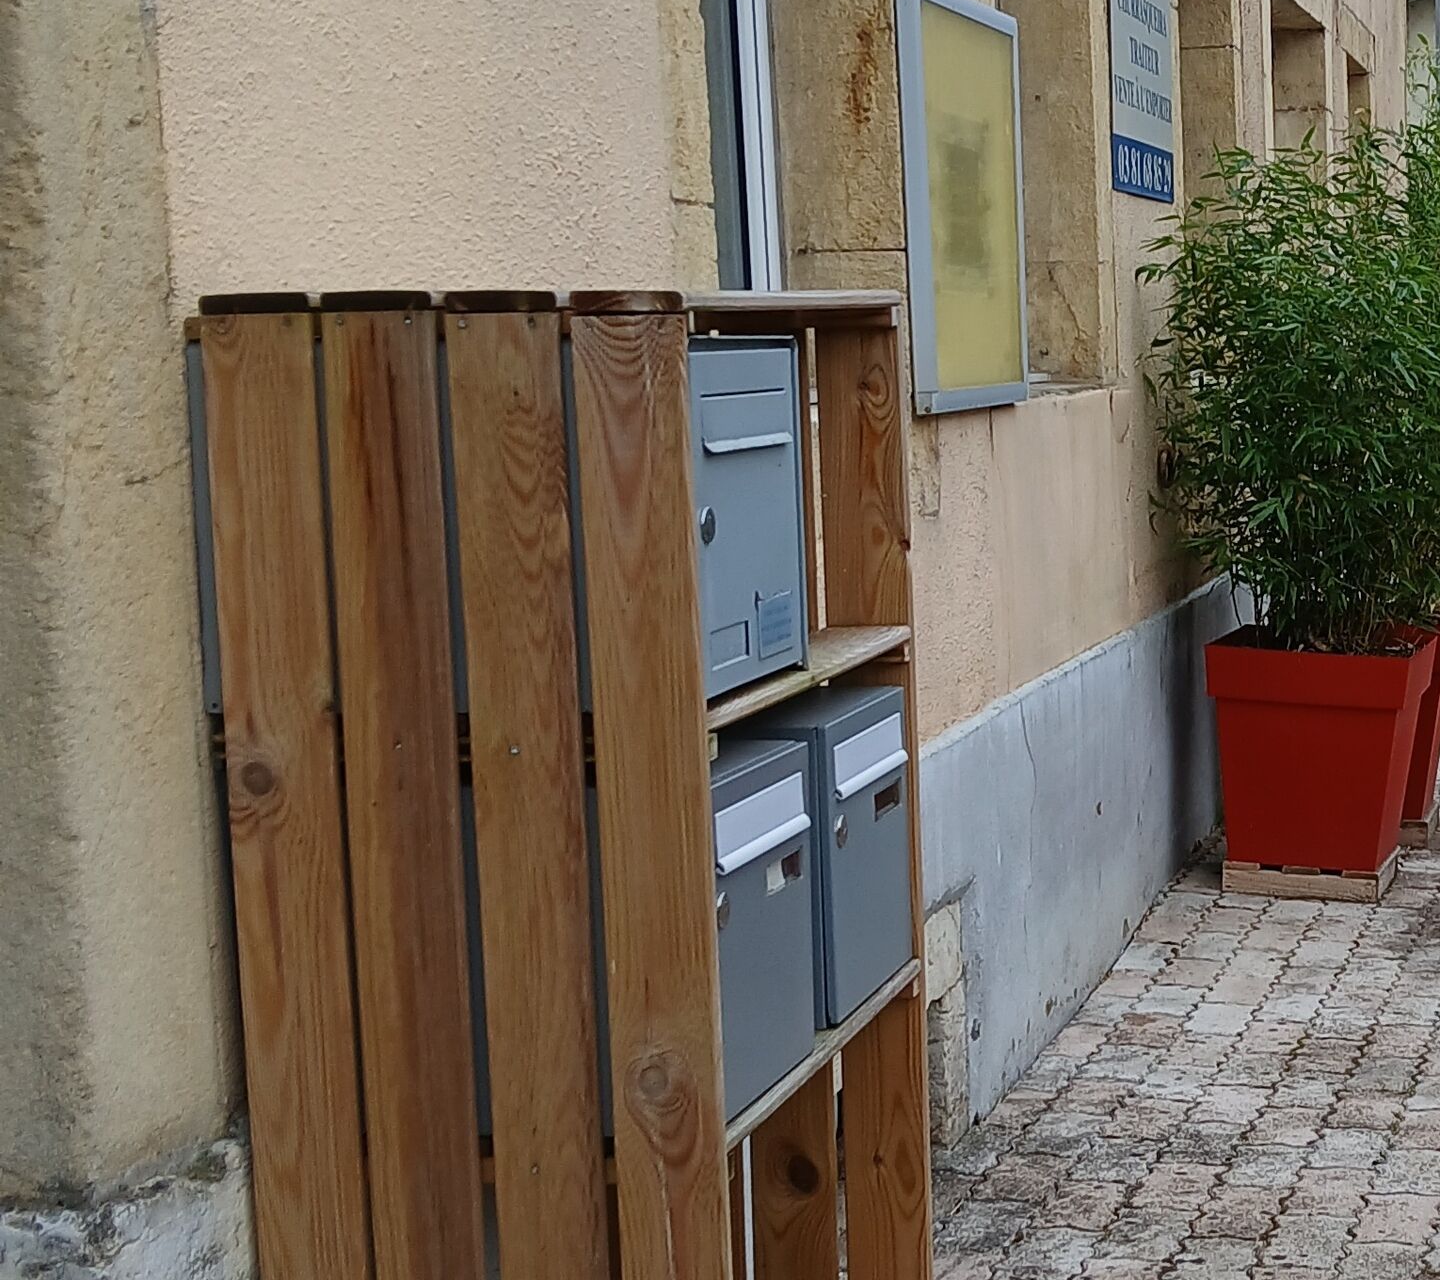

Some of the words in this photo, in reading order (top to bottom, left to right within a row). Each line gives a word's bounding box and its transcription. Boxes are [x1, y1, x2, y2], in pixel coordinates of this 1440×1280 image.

[1129, 36, 1159, 76] TRAITEUR
[1114, 74, 1136, 110] VENTE
[1118, 144, 1130, 184] 03
[1131, 147, 1142, 187] 81
[1143, 150, 1153, 192] 68
[1154, 154, 1163, 192] 85
